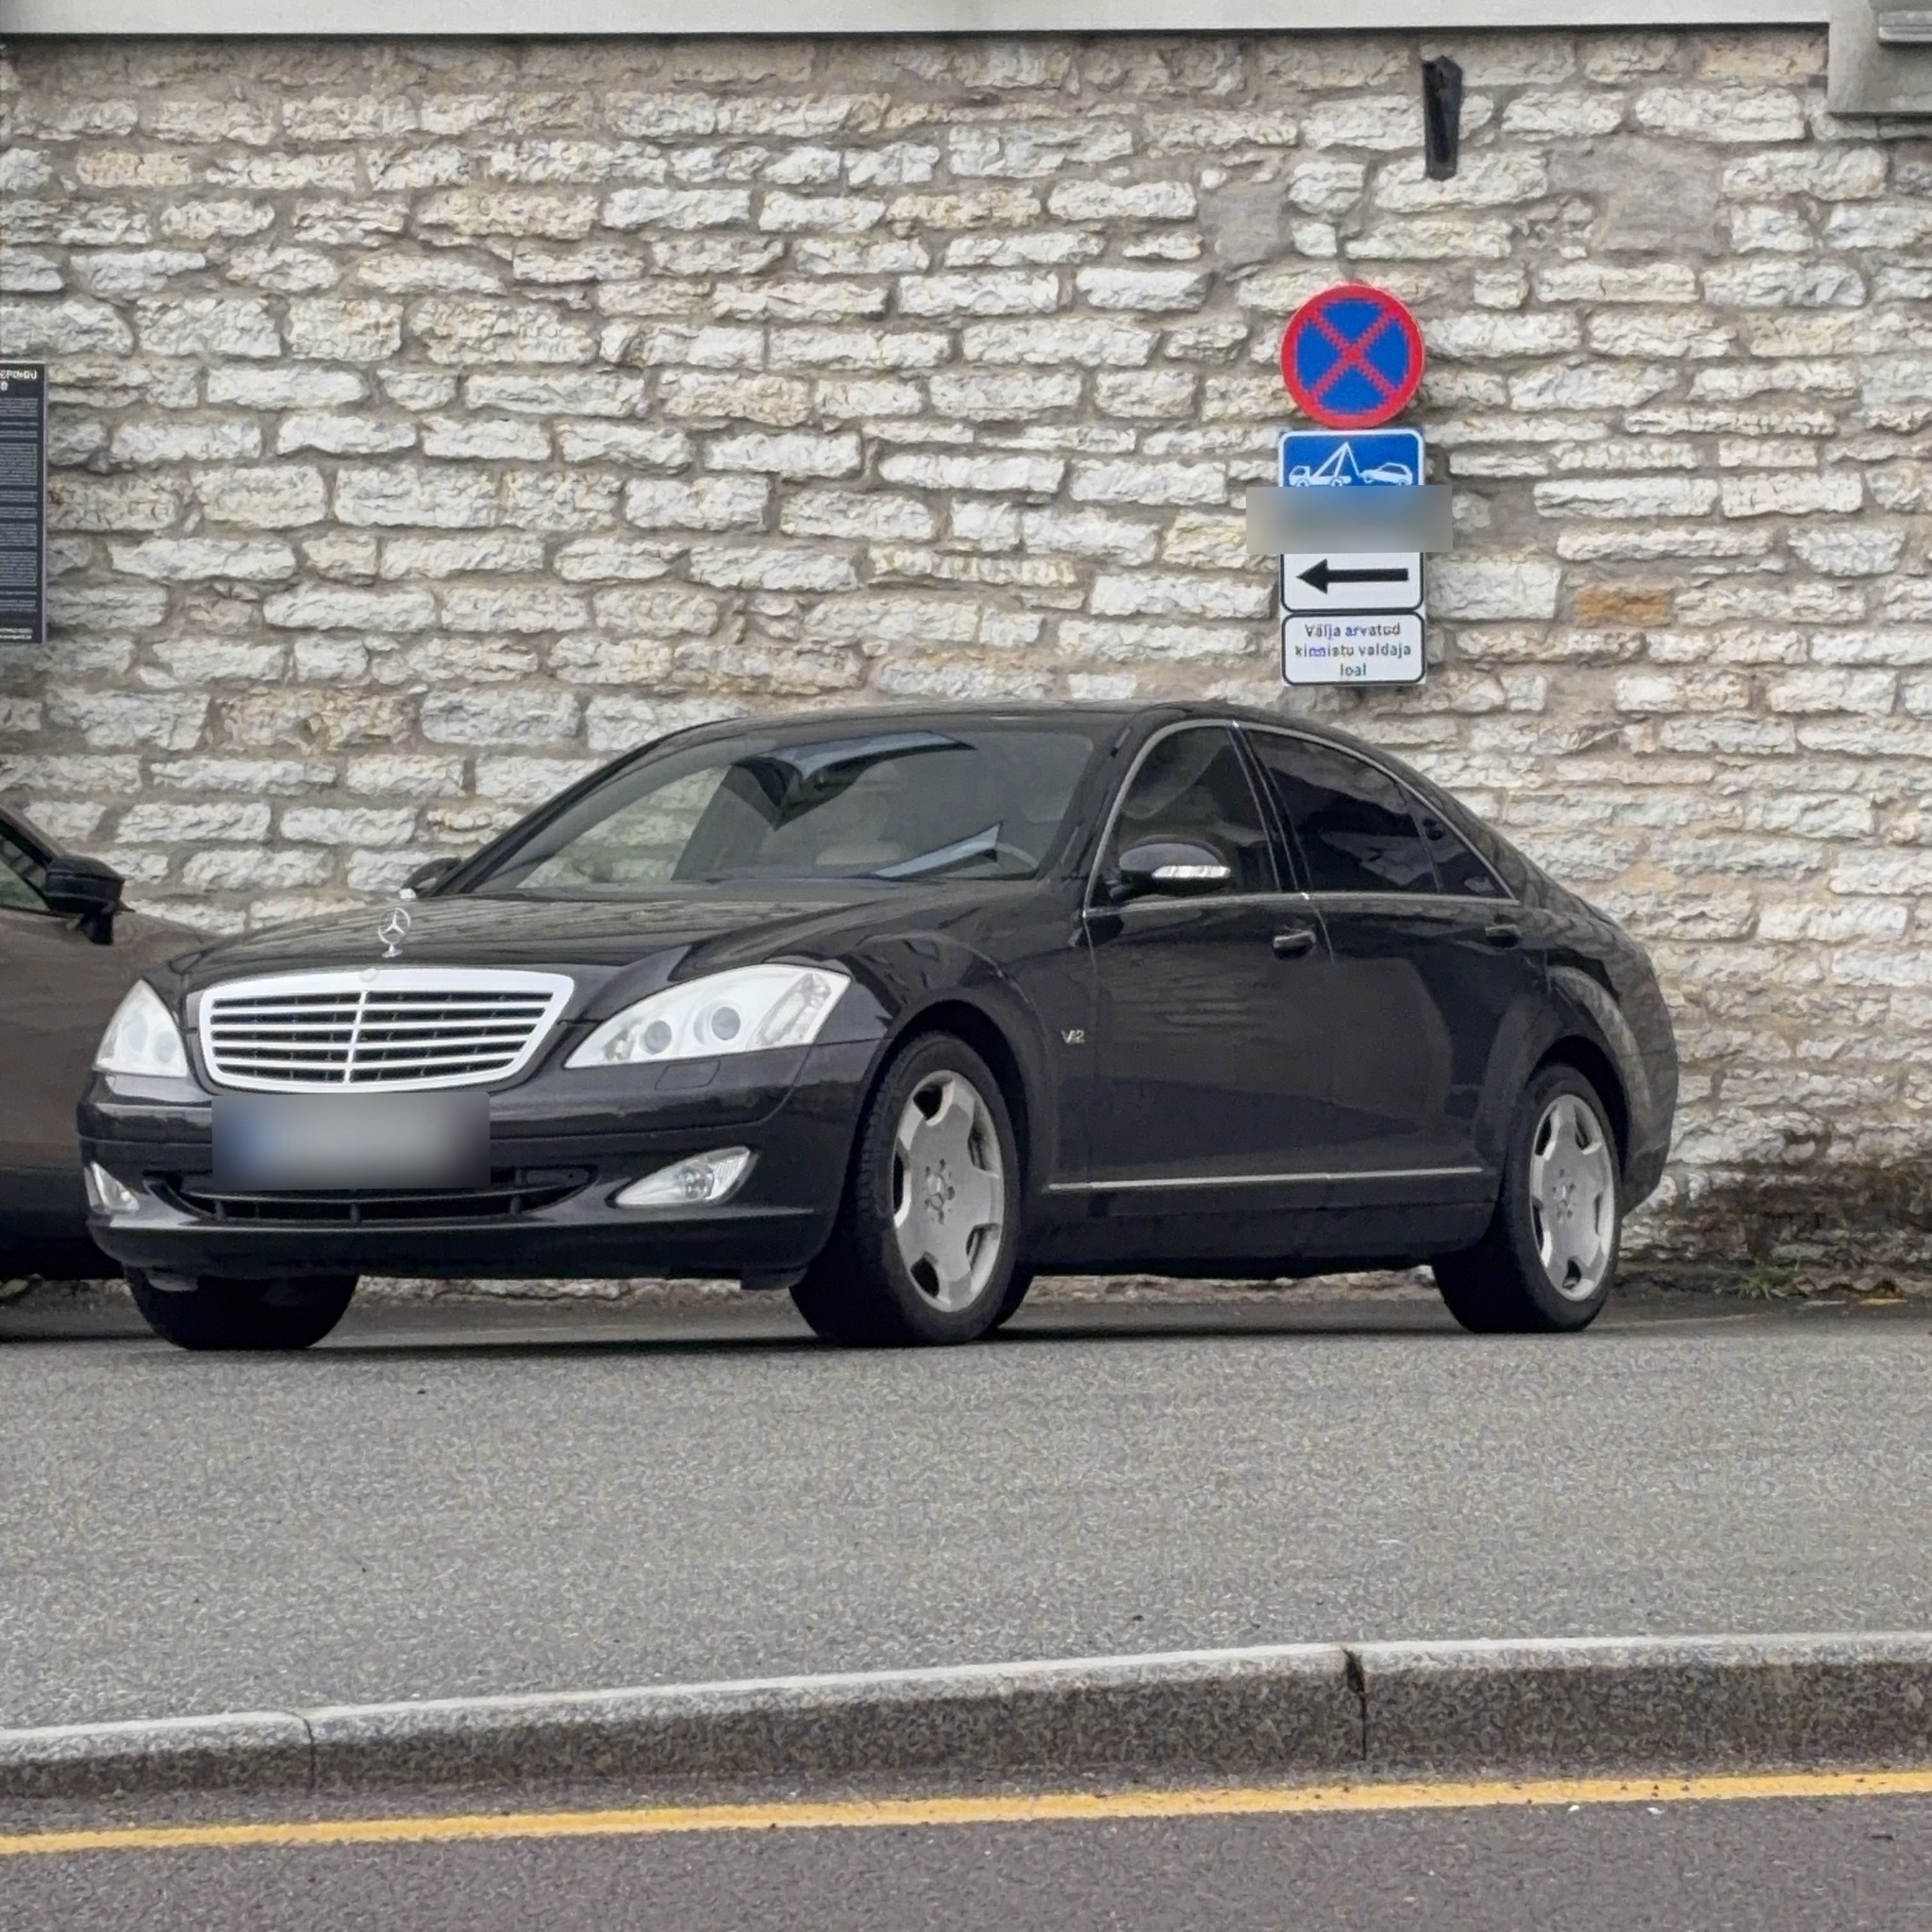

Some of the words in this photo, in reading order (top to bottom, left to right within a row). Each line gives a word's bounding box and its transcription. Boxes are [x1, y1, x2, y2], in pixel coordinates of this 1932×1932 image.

[1305, 624, 1341, 640] Välja
[1344, 623, 1401, 638] arvatud
[1358, 641, 1411, 658] valdaja
[1340, 662, 1367, 677] loal
